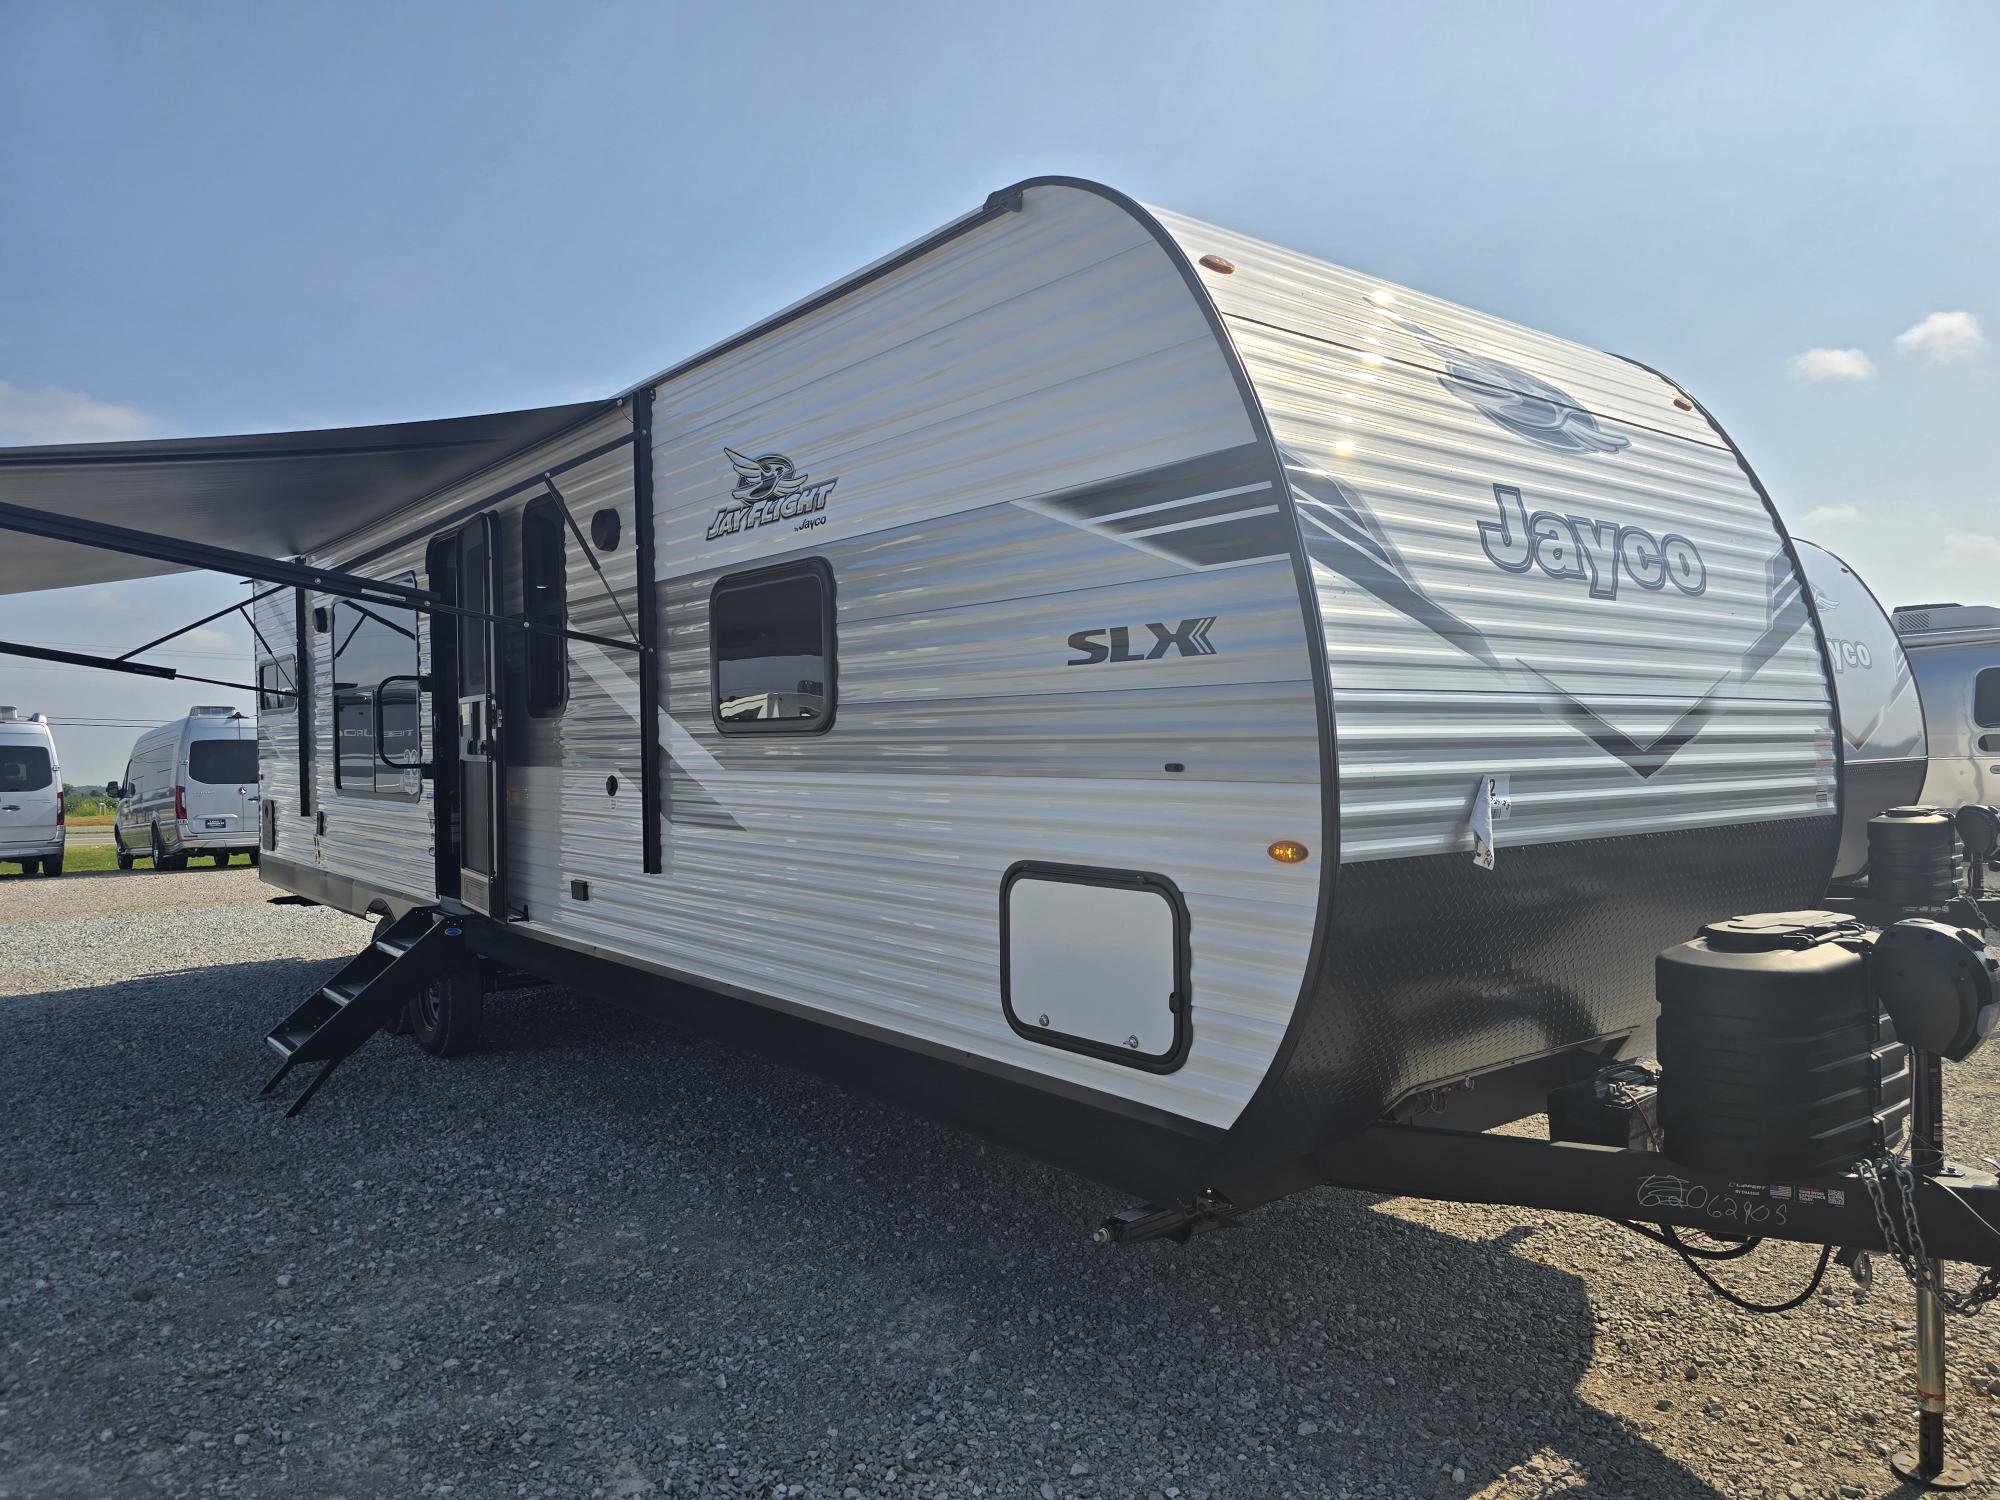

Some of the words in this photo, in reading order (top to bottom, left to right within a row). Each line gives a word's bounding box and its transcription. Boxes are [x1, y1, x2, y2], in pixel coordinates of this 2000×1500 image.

[798, 515, 827, 531] Jayco
[1476, 483, 1707, 601] Jayco
[1068, 616, 1217, 666] SLX
[1824, 637, 1873, 674] yco
